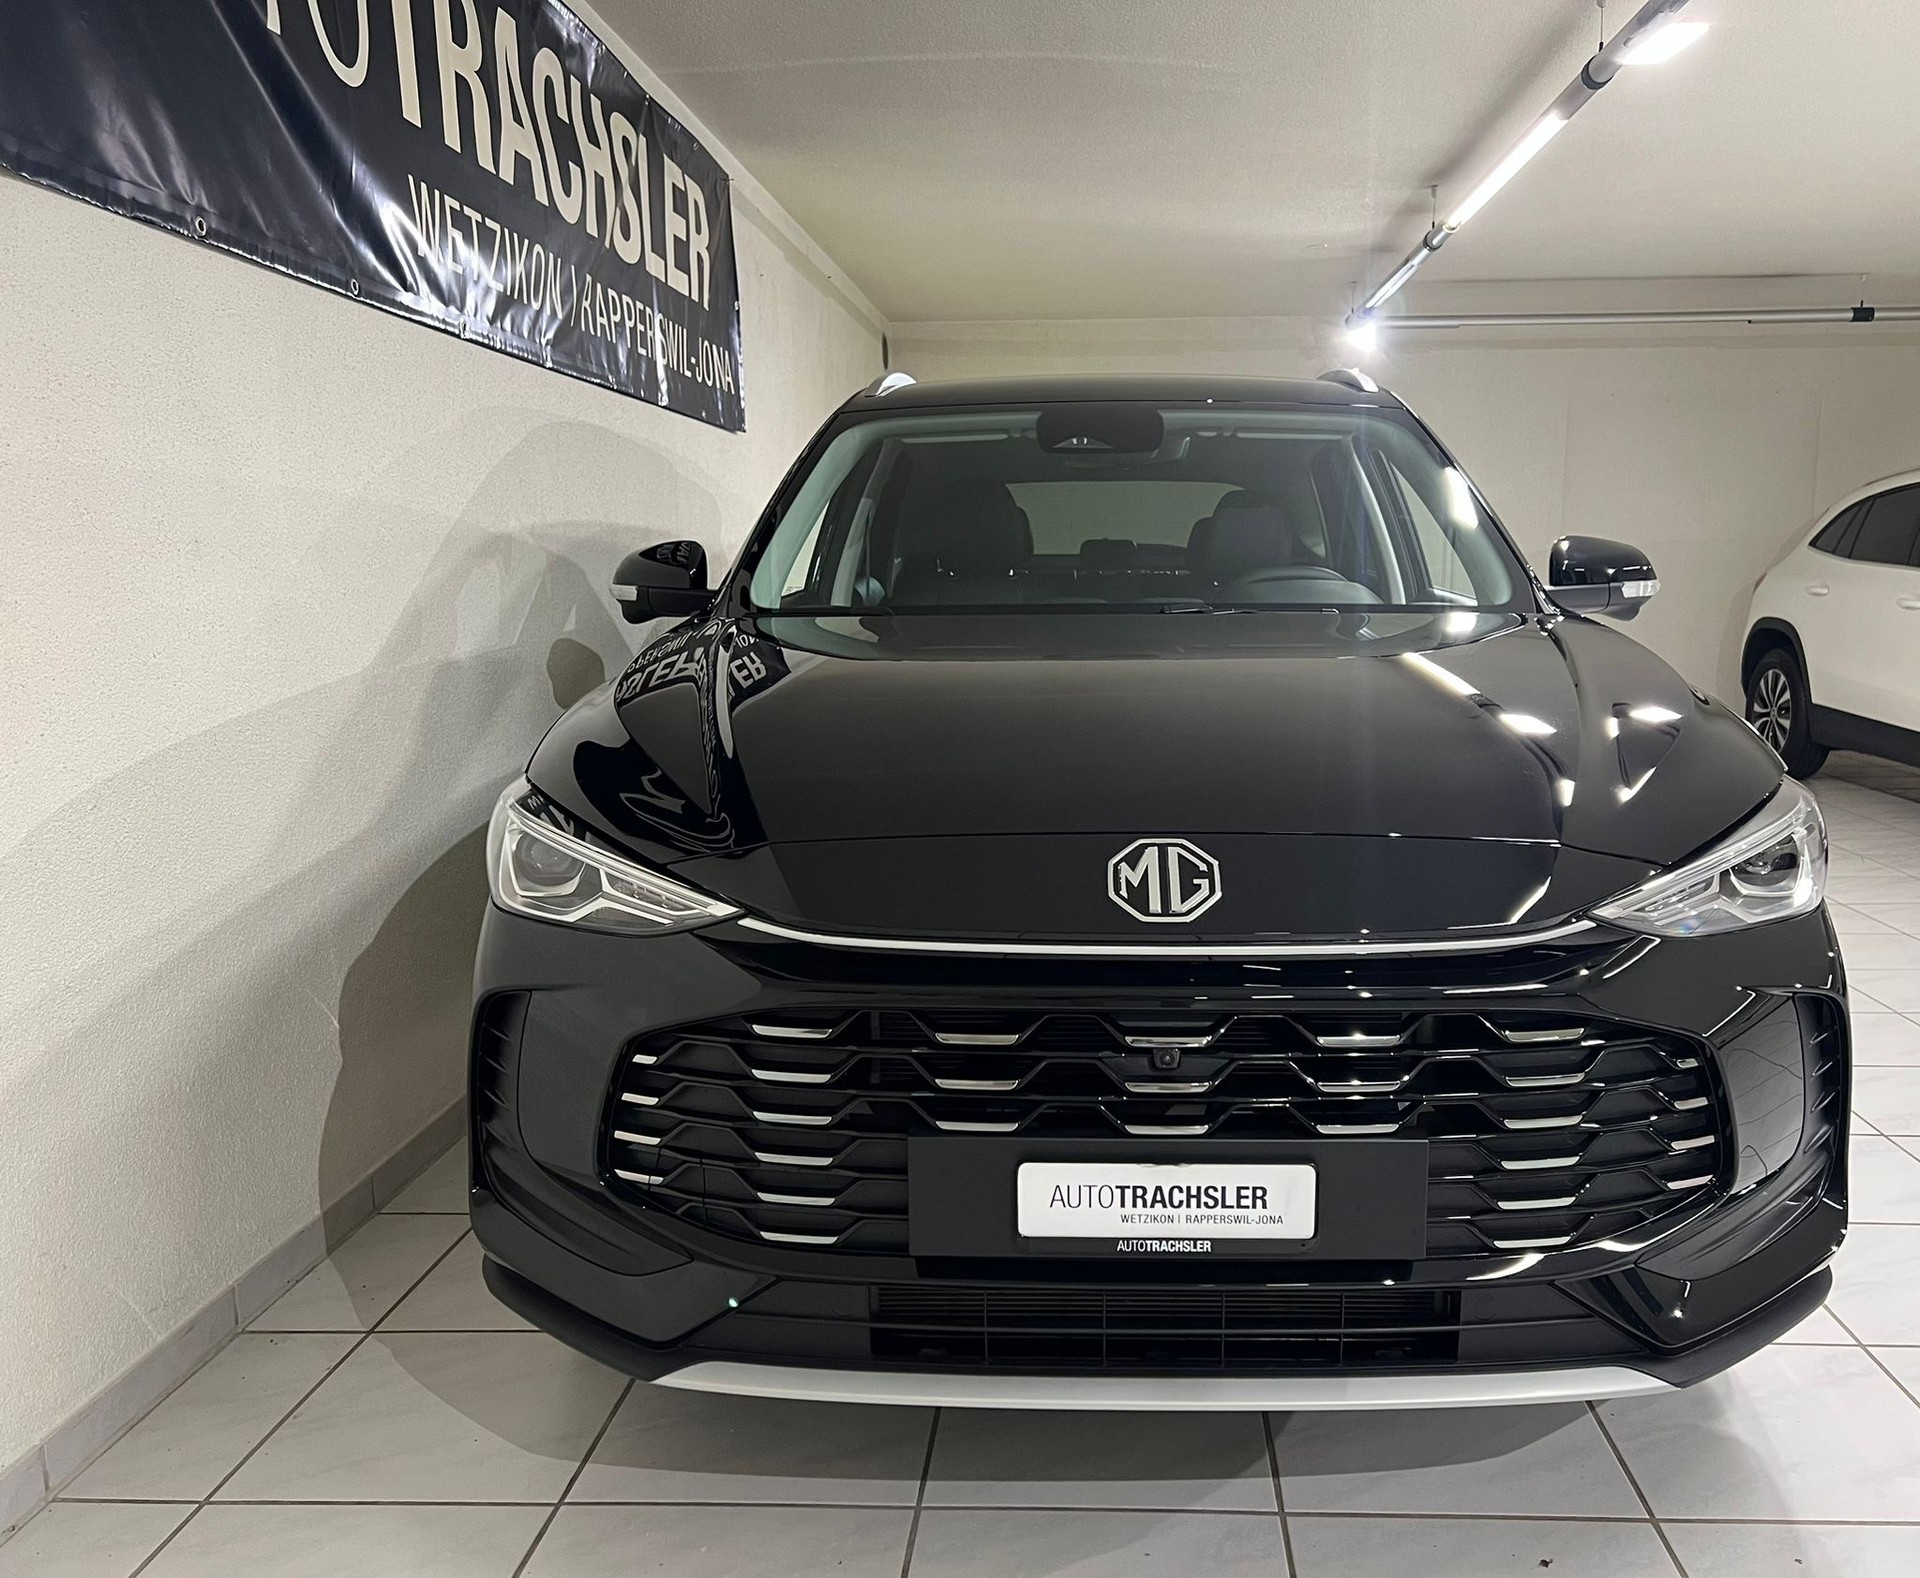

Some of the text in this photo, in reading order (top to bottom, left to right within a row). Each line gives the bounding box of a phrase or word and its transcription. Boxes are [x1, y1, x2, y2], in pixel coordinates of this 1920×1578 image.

[407, 173, 563, 320] WETZIKON
[581, 273, 735, 396] RAPPERSWIL-JONA
[1117, 846, 1210, 914] MG
[1049, 1184, 1269, 1210] AUTOTRACHSLER
[1120, 1213, 1175, 1225] WETZIKON
[1185, 1213, 1285, 1226] RAPPERSWIL-JONA
[1116, 1239, 1212, 1254] AUTOTRACHSLER
